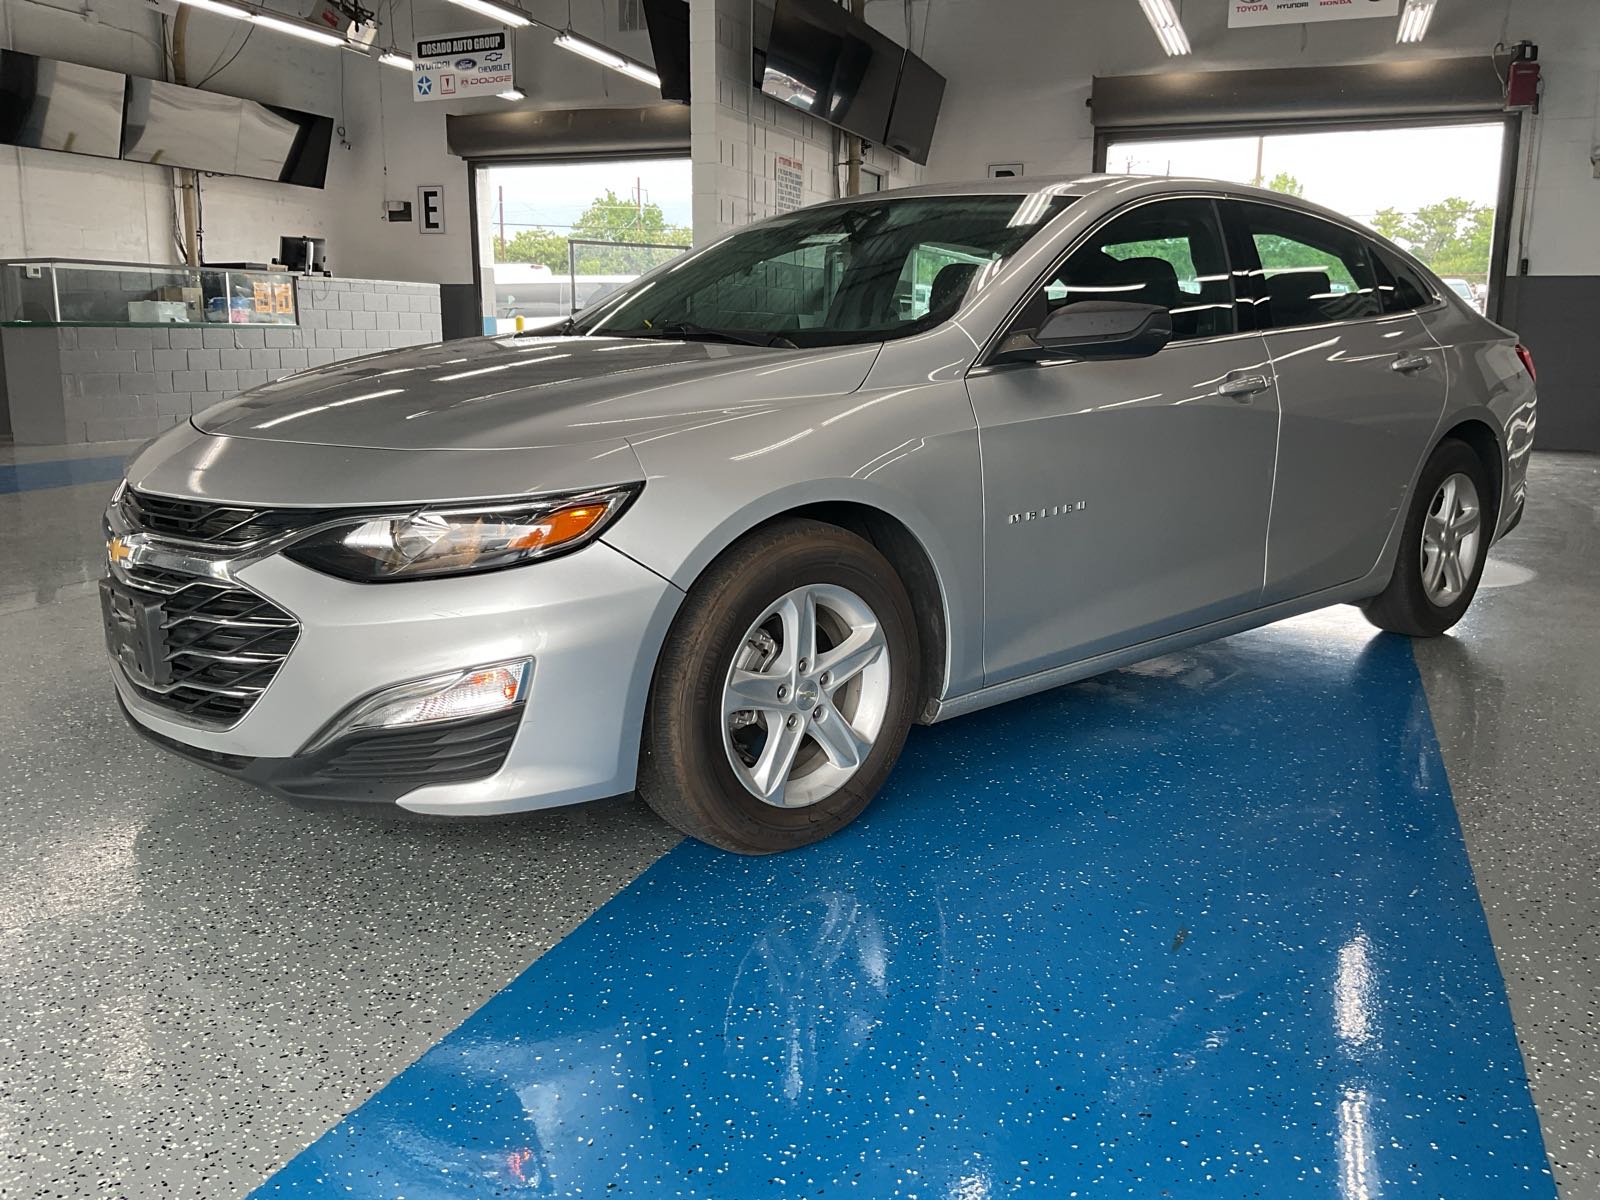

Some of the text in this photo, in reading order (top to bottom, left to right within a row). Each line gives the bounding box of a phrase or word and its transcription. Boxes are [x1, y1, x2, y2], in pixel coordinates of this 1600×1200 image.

[1236, 5, 1268, 13] TOYOTA
[421, 36, 501, 55] ROSADO AUTO GROUP
[478, 63, 511, 73] CHEVROLET
[470, 75, 512, 85] DODGE
[424, 191, 439, 229] E
